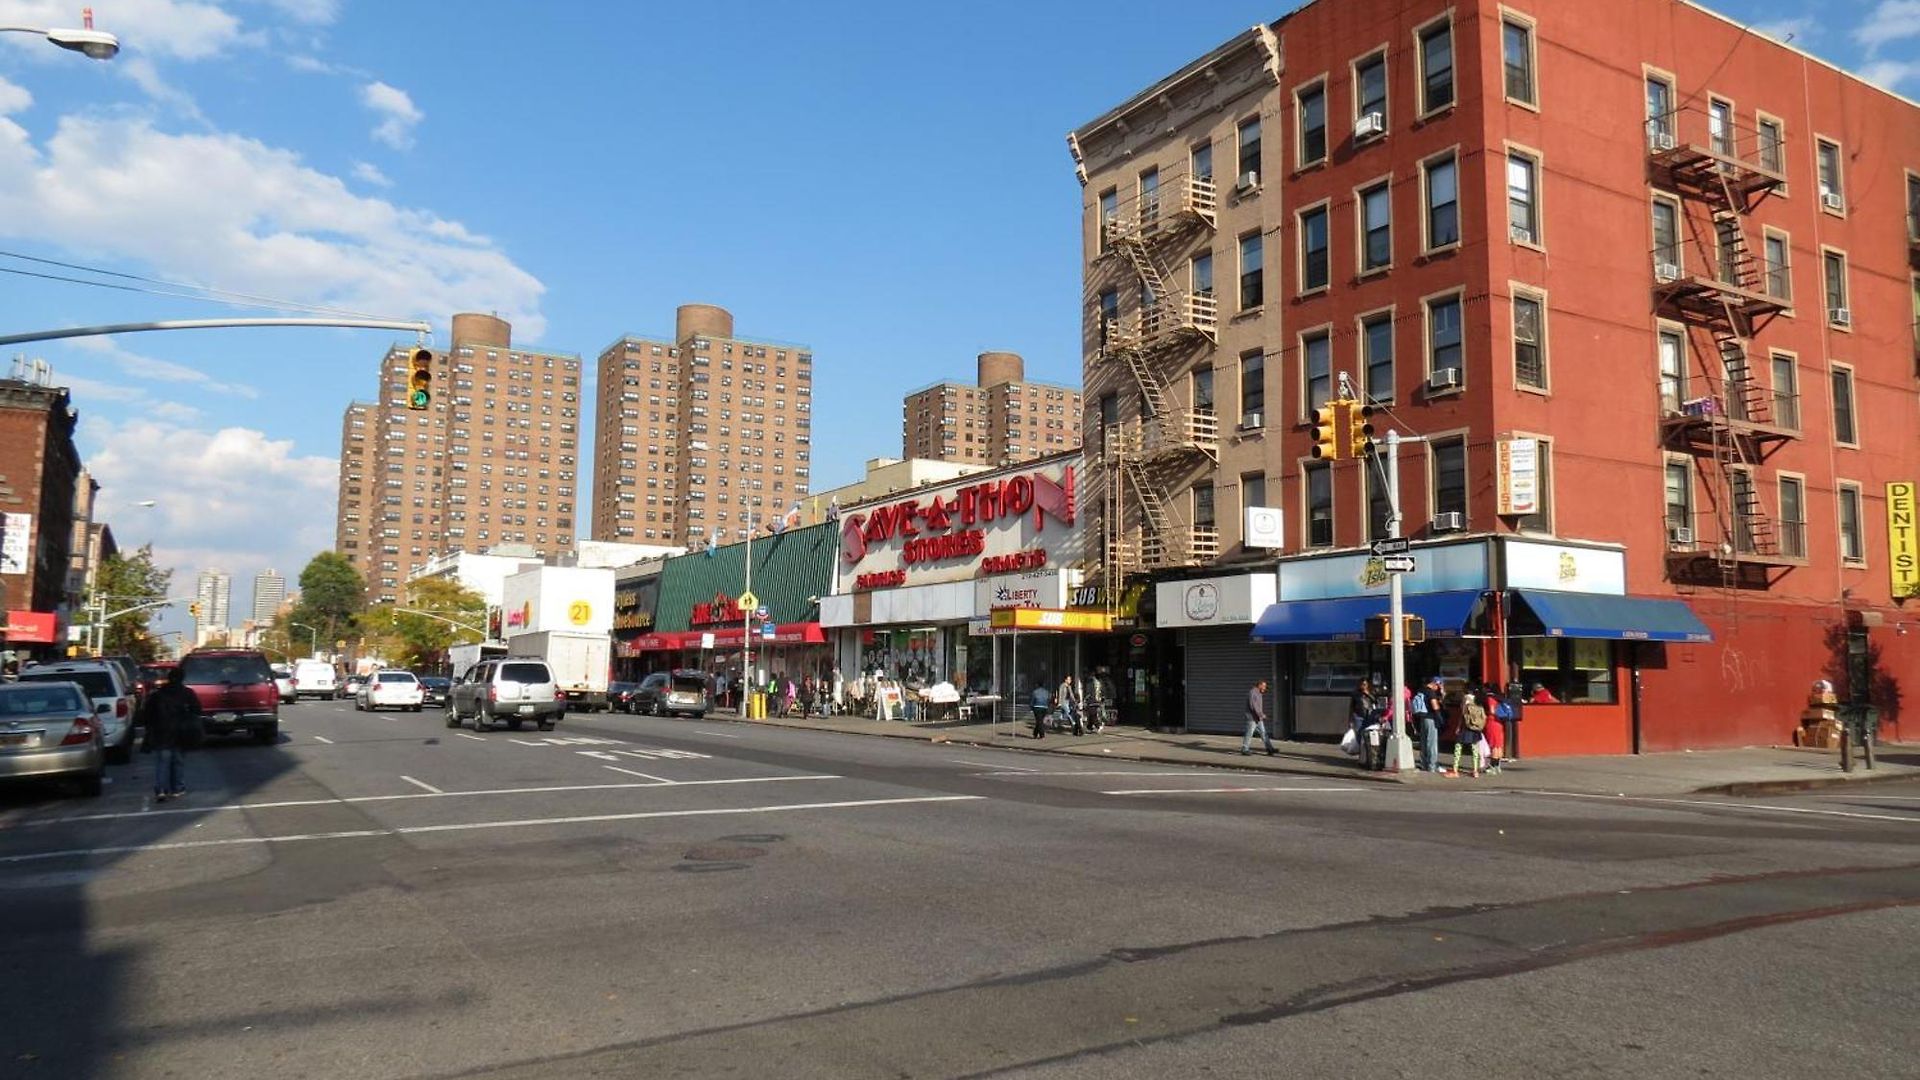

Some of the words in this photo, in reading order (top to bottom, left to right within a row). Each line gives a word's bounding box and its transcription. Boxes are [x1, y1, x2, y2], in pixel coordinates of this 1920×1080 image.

[1500, 442, 1510, 513] DENTIST
[843, 465, 1075, 563] SAVE-A-THON
[1891, 484, 1913, 582] DENTIST
[903, 528, 985, 565] STORES
[571, 604, 590, 621] 21
[1007, 589, 1039, 600] LIBERTY
